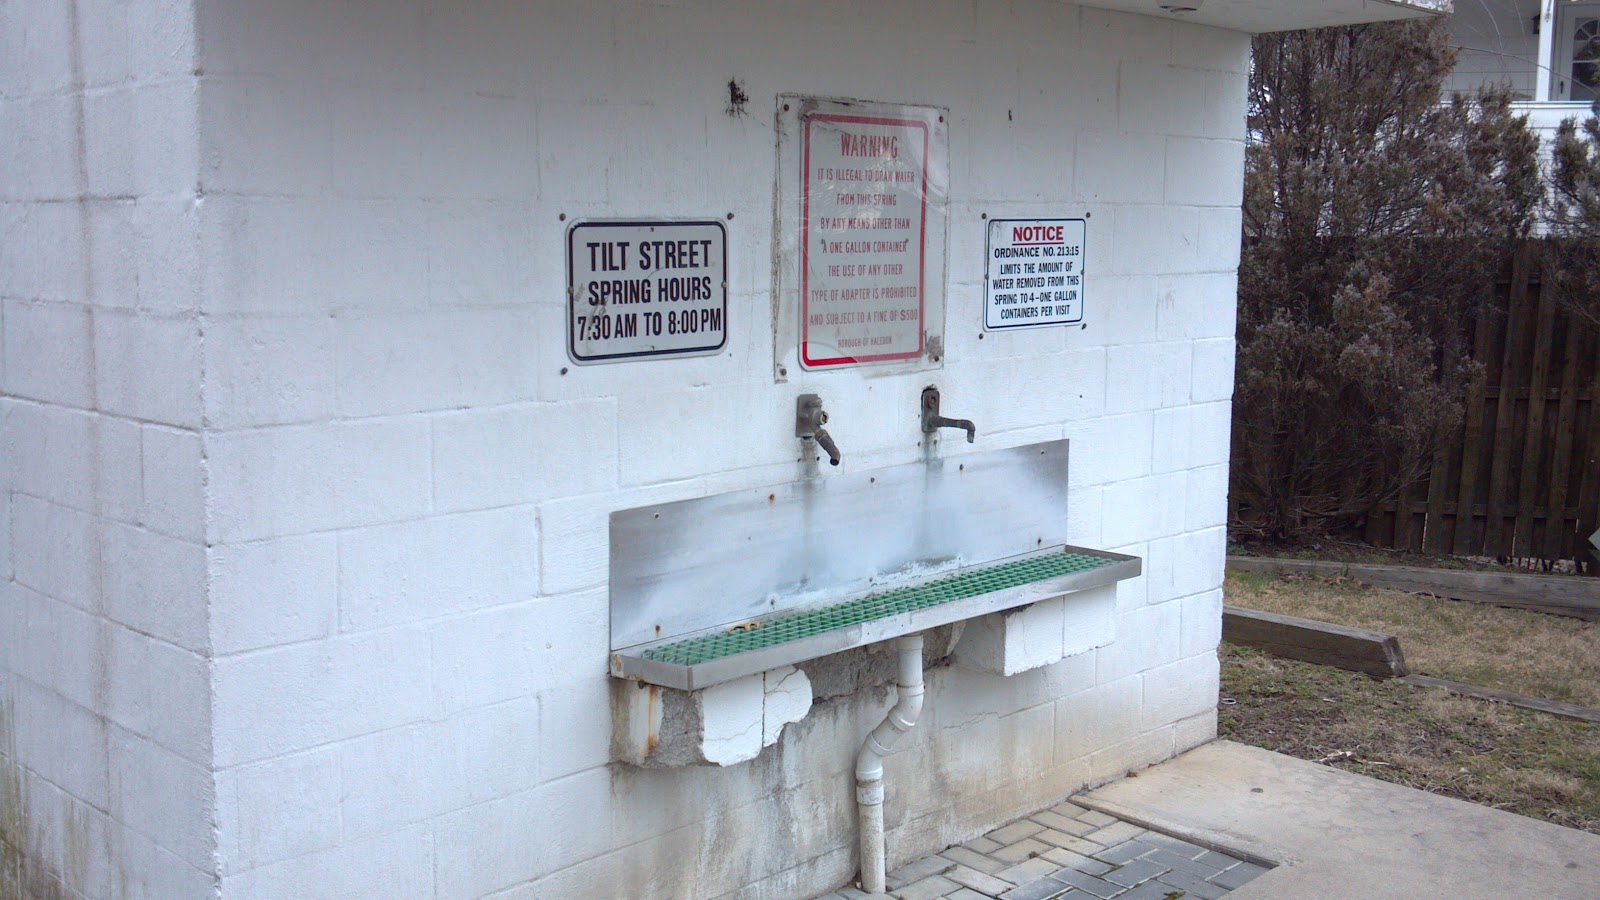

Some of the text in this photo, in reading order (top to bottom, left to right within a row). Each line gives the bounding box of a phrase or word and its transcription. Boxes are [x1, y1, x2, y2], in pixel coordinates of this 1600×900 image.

[841, 134, 898, 158] WARNING
[818, 168, 914, 182] IT IS ILLEGAL TO DRAW WATER
[836, 194, 896, 206] FROM THIS SPRING
[820, 218, 910, 229] BY ANY MEANS OTHER THAN
[1013, 226, 1064, 241] NOTICE
[830, 242, 842, 254] ONE
[846, 241, 870, 253] GALLON
[994, 247, 1039, 258] ORDINANCE
[1043, 247, 1055, 256] NO.
[587, 240, 711, 271] TILT STREET
[828, 264, 903, 277] THE USE OF ANY OTHER
[1000, 262, 1073, 274] LIMITS THE AMOUNT OF
[993, 275, 1079, 290] WATER REMOVED FROM THIS
[588, 276, 711, 306] SPRING HOURS
[812, 286, 917, 302] TYPE OF ADAPTER IS PROHIBITED
[995, 294, 1017, 305] SPRING
[1020, 293, 1028, 303] TO
[1054, 290, 1077, 301] GALLON
[810, 314, 823, 326] AND
[826, 312, 855, 325] SUBJECT
[857, 312, 864, 323] TO
[867, 311, 872, 322] A
[874, 310, 888, 322] FINE
[890, 310, 898, 321] OF
[1001, 305, 1070, 319] CONTAINERS PER VISIT
[577, 308, 721, 341] 7:30 AM TO 8:00 PM
[838, 338, 860, 348] BOROUGH
[862, 338, 870, 346] OF
